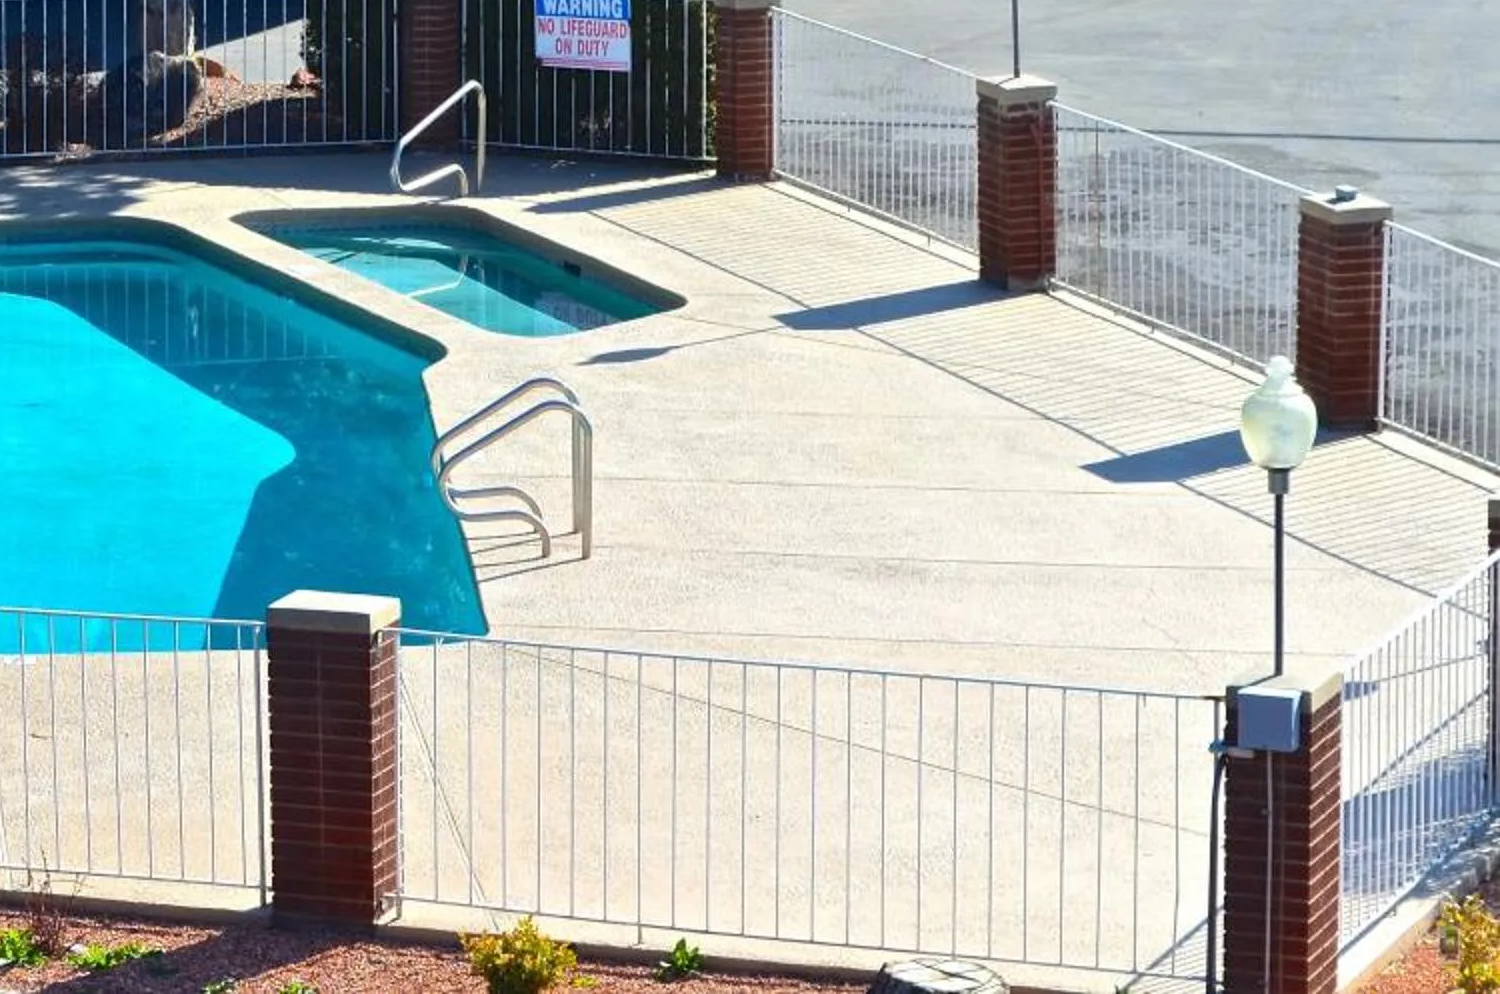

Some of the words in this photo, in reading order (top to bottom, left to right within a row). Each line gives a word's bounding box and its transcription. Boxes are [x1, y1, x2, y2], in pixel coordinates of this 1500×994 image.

[538, 18, 554, 34] NO
[561, 19, 626, 38] LIFEGUARD
[555, 37, 572, 55] ON
[578, 39, 609, 57] DUTY
